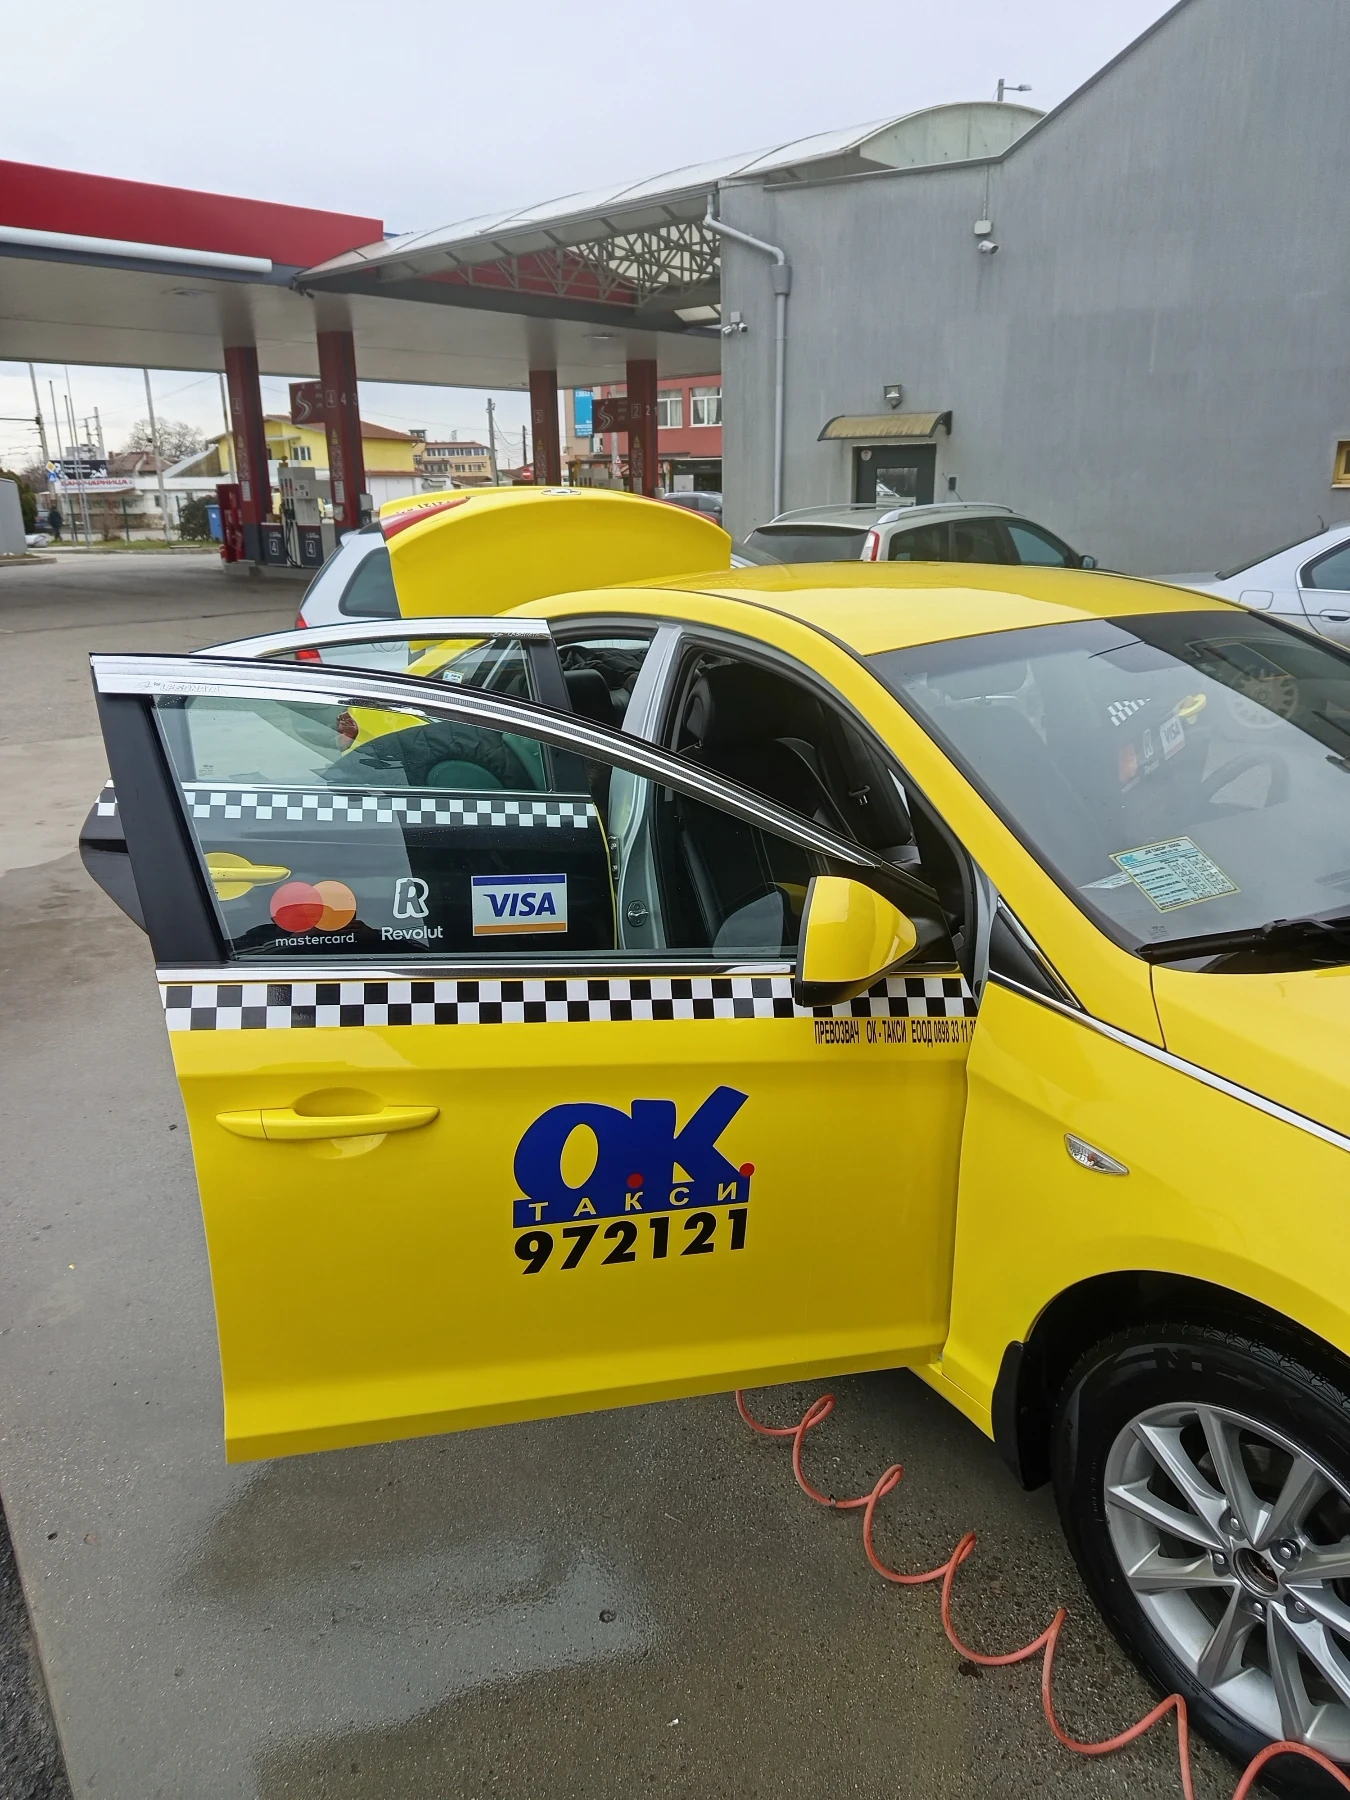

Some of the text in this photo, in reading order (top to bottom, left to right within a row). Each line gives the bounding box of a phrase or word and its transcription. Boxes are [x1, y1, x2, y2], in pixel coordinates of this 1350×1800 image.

[340, 392, 347, 405] 4
[645, 405, 651, 416] 2
[483, 891, 557, 917] VISA
[381, 925, 443, 941] Revolut
[814, 1020, 860, 1044] ПРЕВОЗВАЧ
[866, 1020, 878, 1043] ОК
[882, 1020, 907, 1043] ТАКСИ
[911, 1020, 933, 1048] ЕООД
[933, 1020, 950, 1043] 0898
[951, 1020, 960, 1043] 33
[961, 1020, 968, 1043] 11
[528, 1181, 738, 1222] ТАКСИ
[513, 1207, 748, 1275] 972121
